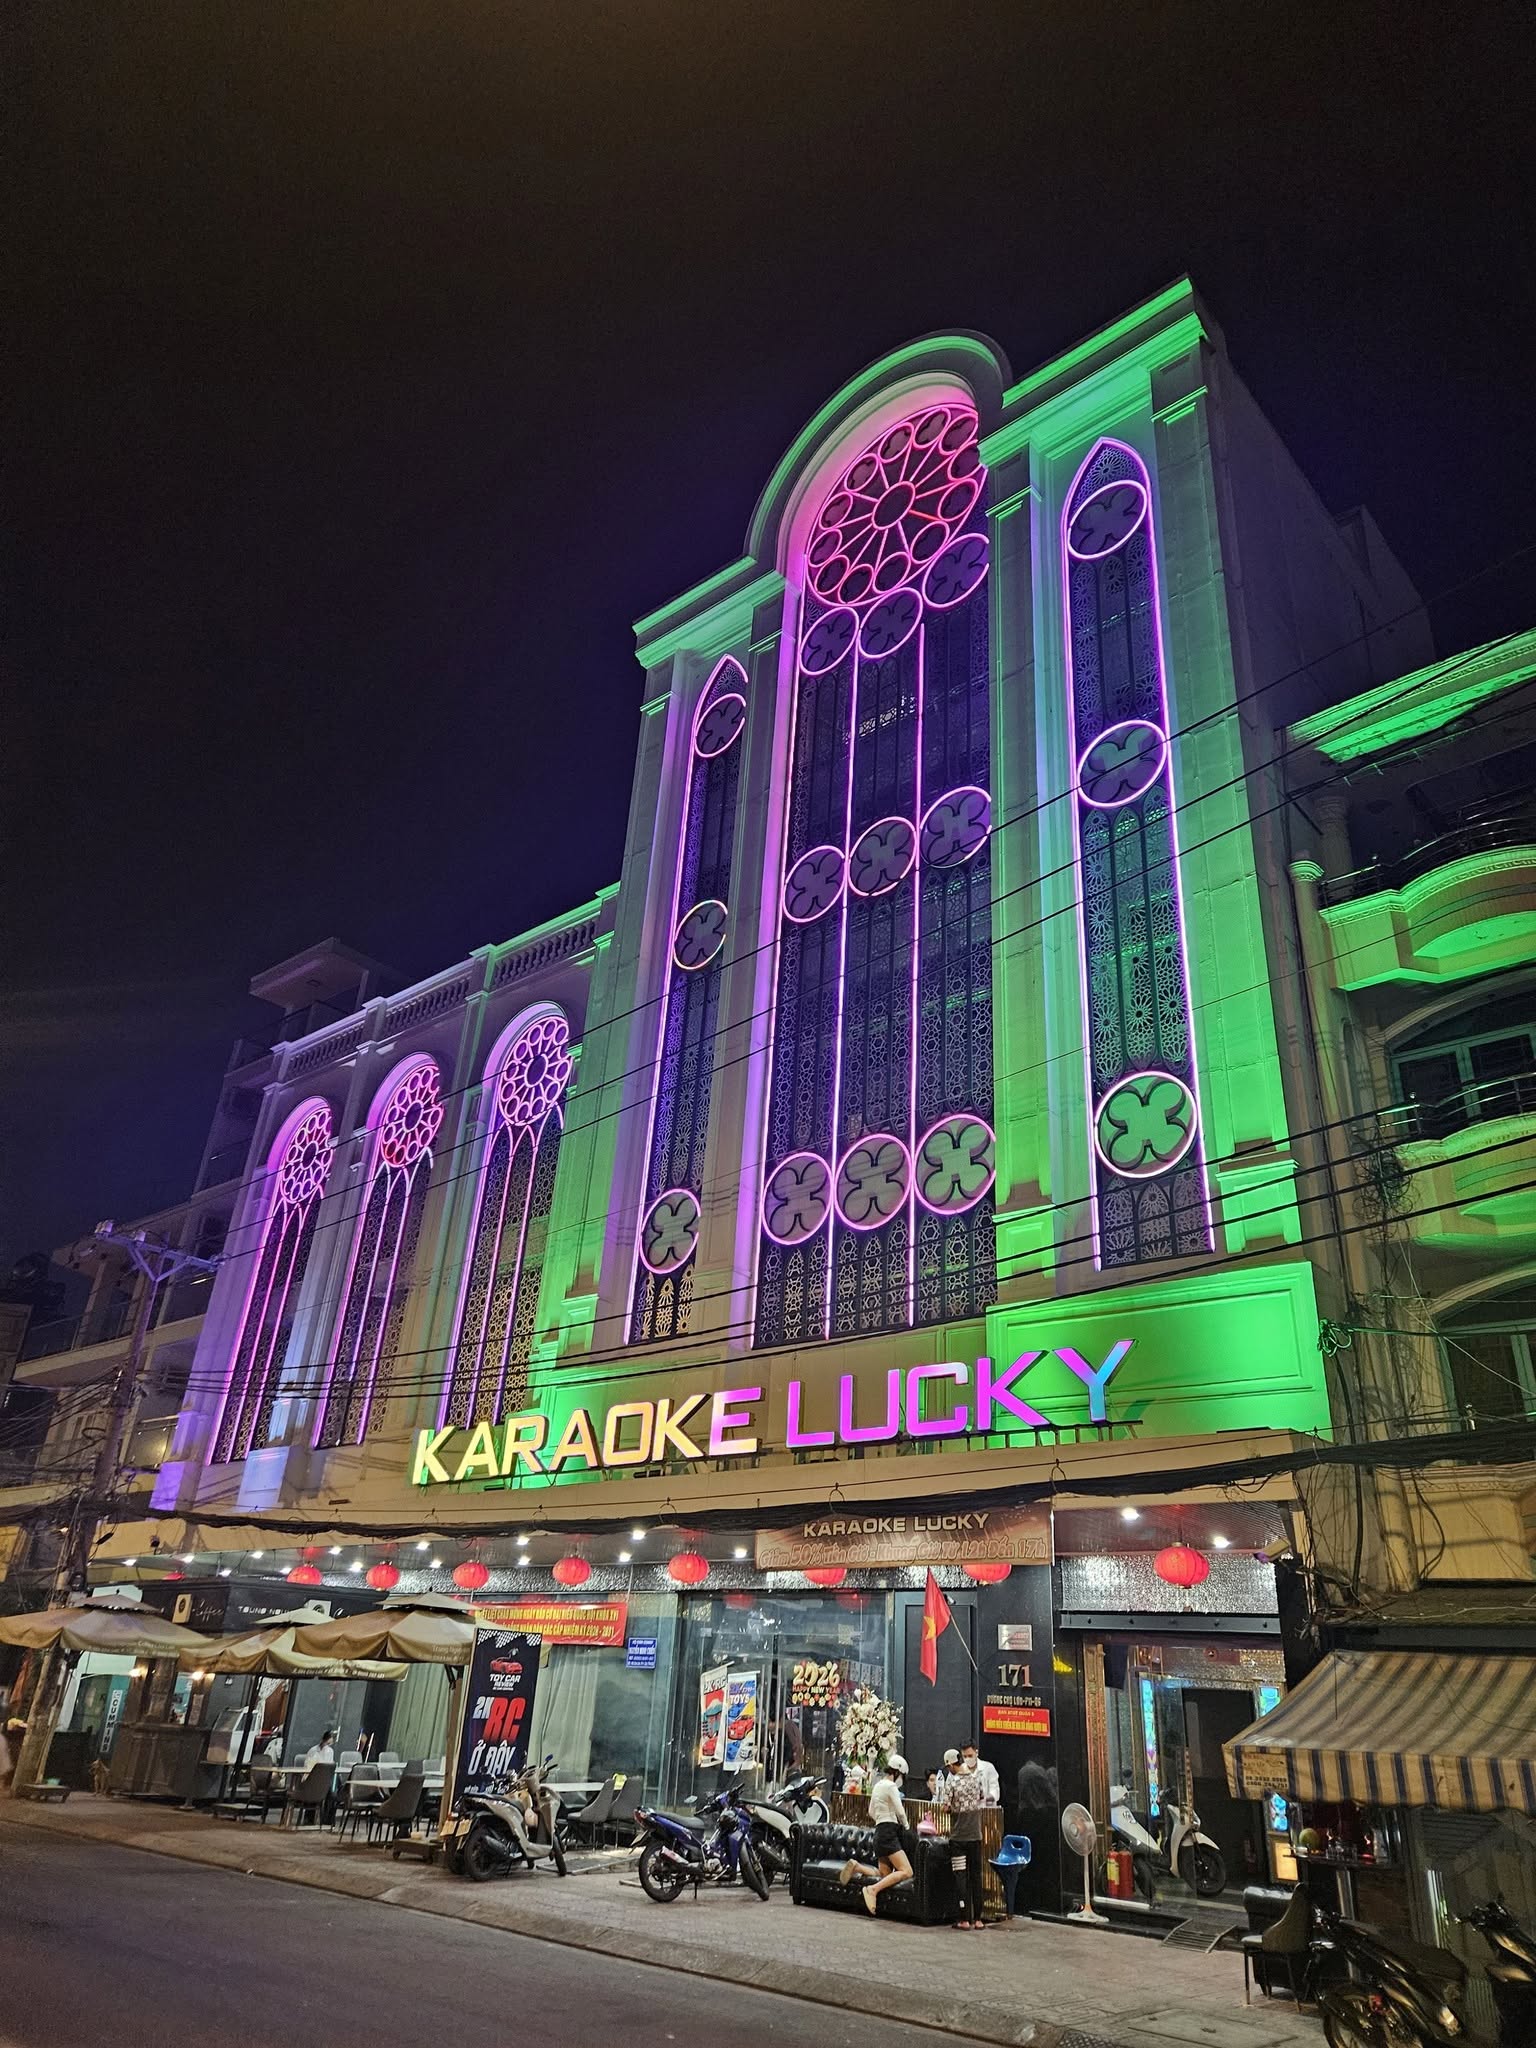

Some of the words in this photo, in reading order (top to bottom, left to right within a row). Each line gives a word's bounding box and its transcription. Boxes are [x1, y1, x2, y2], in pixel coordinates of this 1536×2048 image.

[412, 1386, 763, 1485] KARAOKE
[785, 1338, 1137, 1448] LUCKY
[803, 1516, 906, 1538] KARAOKE
[913, 1512, 989, 1532] LUCKY
[1017, 1537, 1047, 1559] 17h
[489, 1674, 506, 1683] TOY
[505, 1675, 521, 1683] CAR
[793, 1661, 841, 1687] 2026
[998, 1664, 1034, 1687] 171
[729, 1694, 750, 1704] TOYS
[792, 1685, 810, 1693] HAPPY
[810, 1685, 825, 1694] NEW
